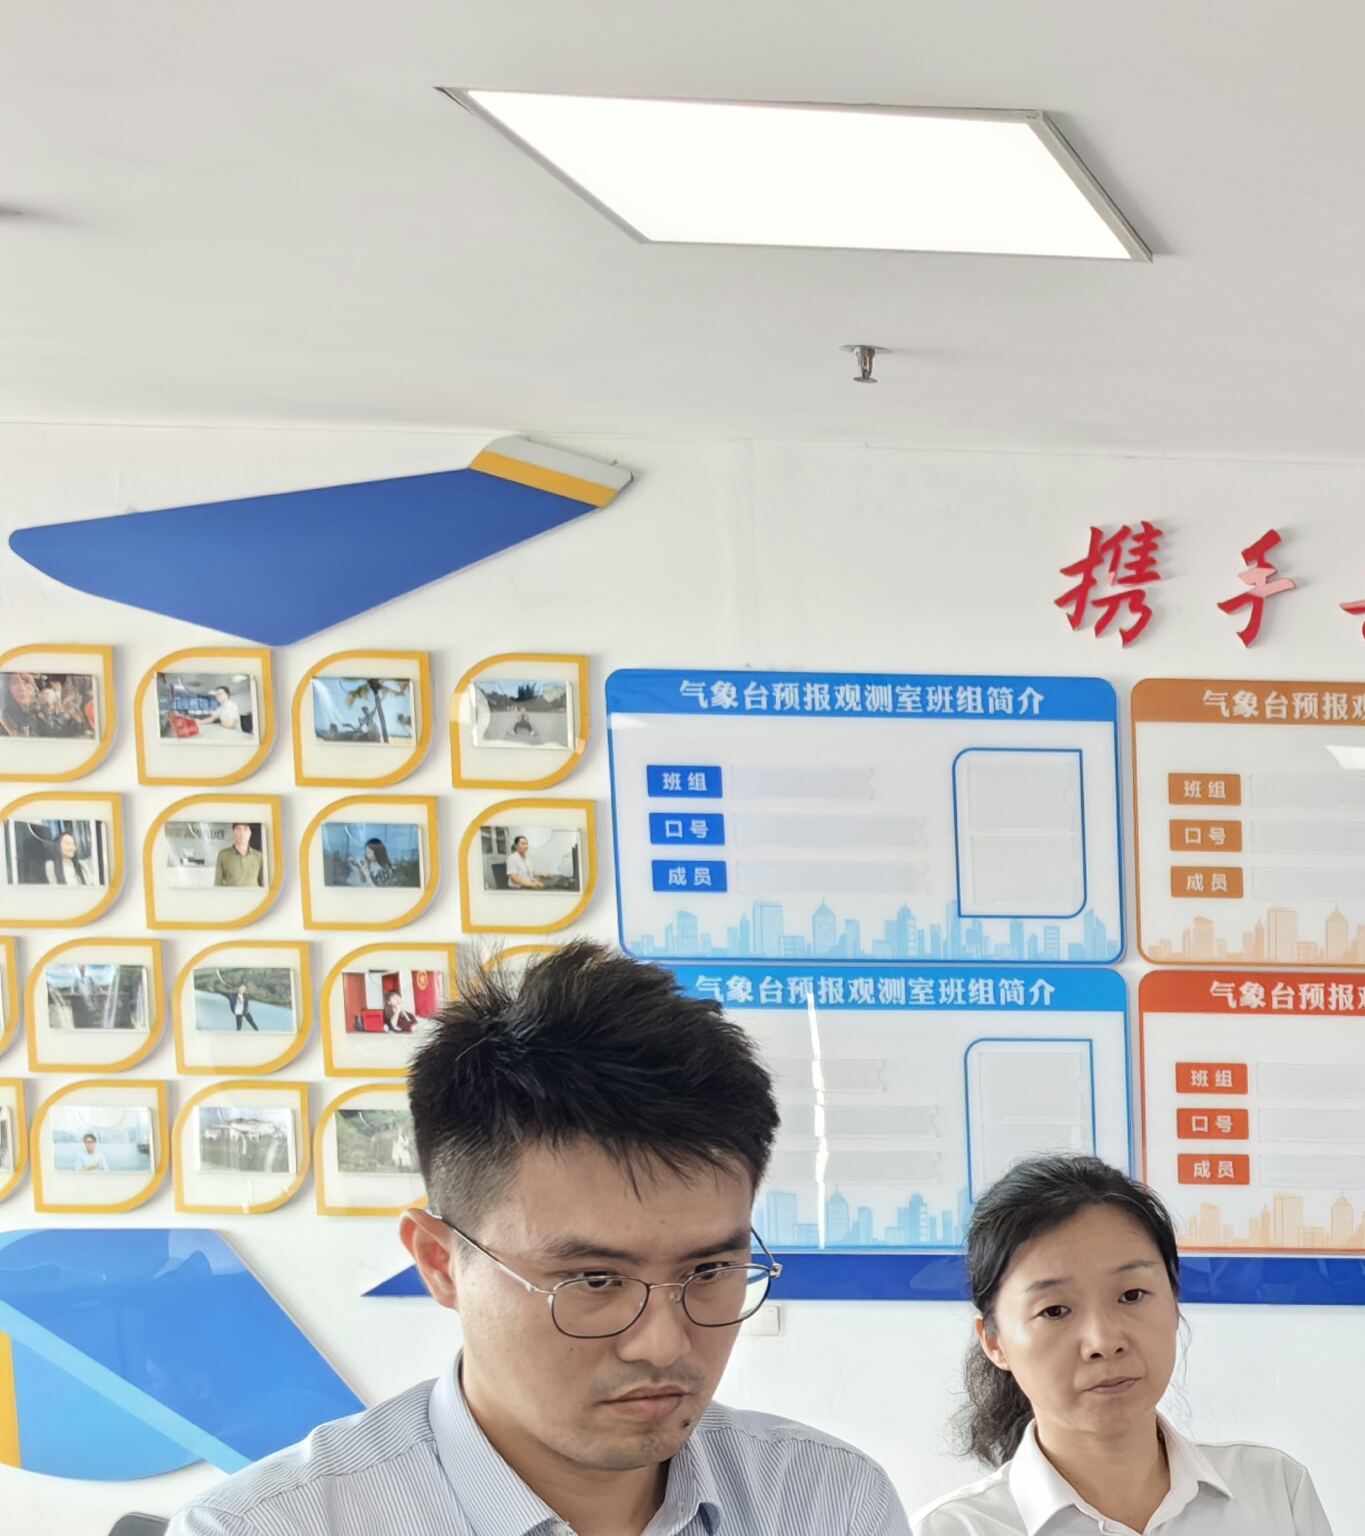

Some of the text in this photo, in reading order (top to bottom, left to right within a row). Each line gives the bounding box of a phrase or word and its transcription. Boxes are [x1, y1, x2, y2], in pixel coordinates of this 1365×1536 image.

[680, 680, 1045, 715] 气象台预报观测室班组简介
[662, 772, 708, 792] 班组
[1183, 780, 1226, 800] 班组
[665, 820, 709, 840] 口号
[1184, 827, 1226, 846] 口号
[667, 866, 712, 887] 成员
[1186, 873, 1228, 893] 成员
[695, 975, 1055, 1007] 气象台预报观测室班组简介
[1190, 1069, 1233, 1088] 班组
[1192, 1115, 1233, 1134] 口号
[1193, 1160, 1235, 1180] 成员
